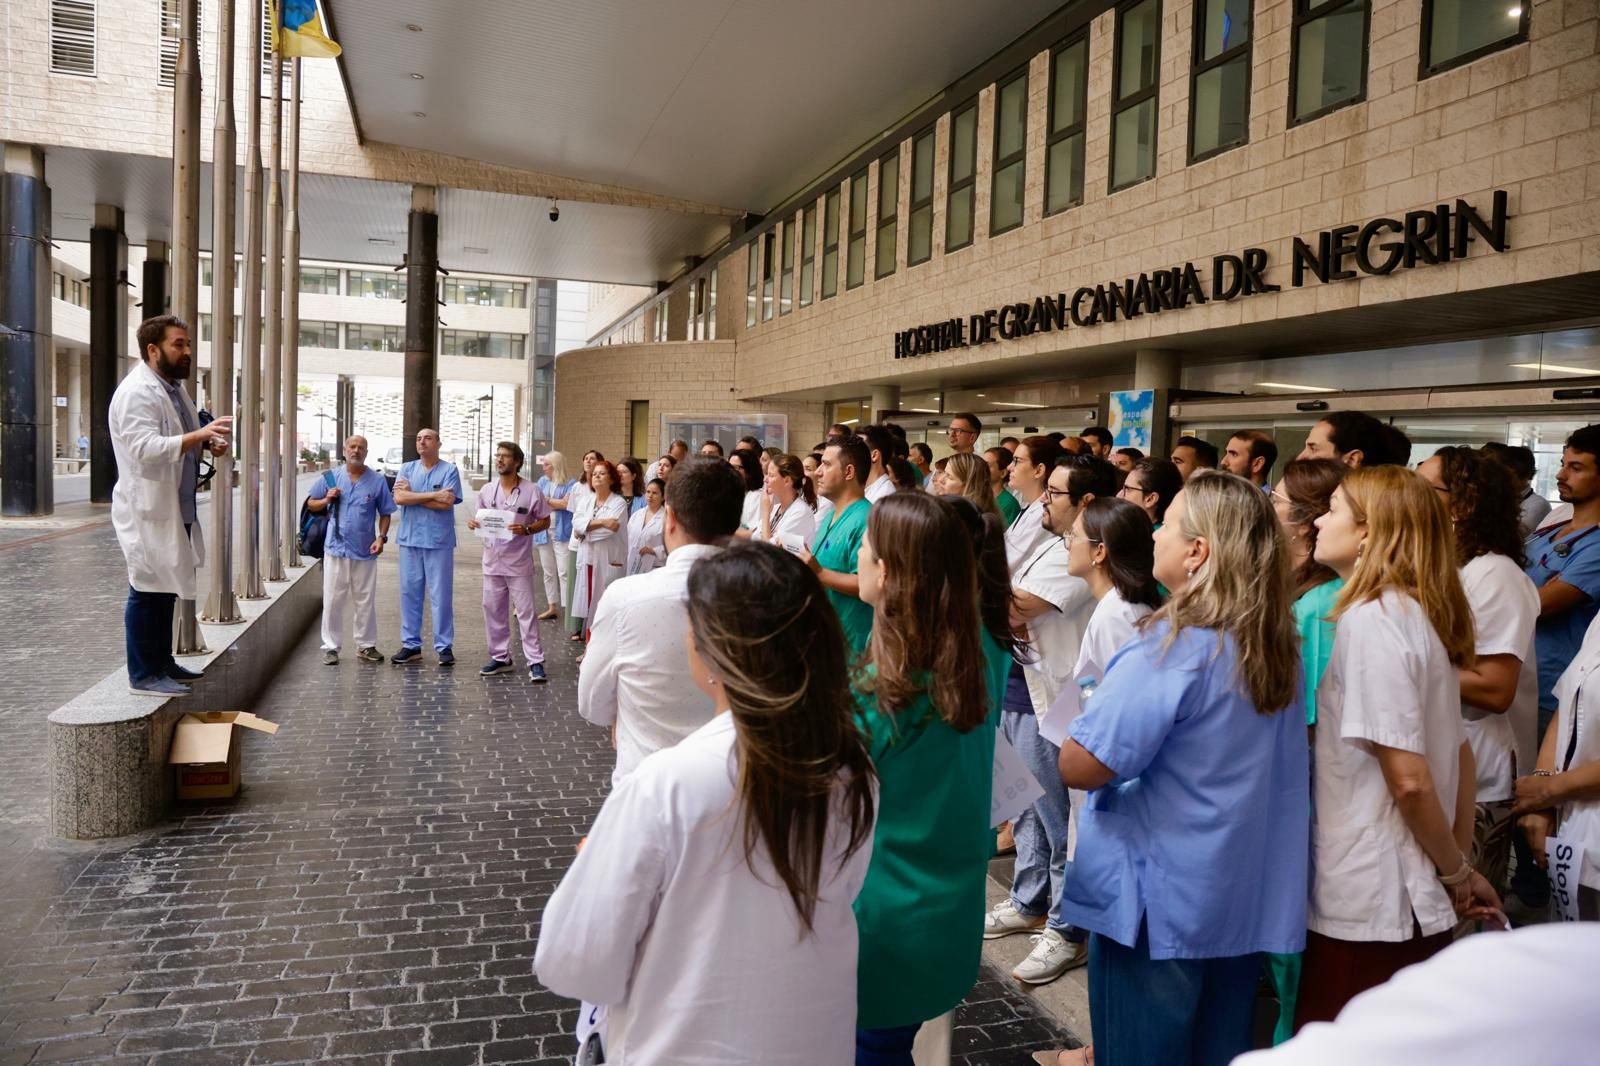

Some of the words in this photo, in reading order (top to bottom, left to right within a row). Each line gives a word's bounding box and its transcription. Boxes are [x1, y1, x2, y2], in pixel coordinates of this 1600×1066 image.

[895, 318, 968, 359] HOSPITAL
[970, 309, 997, 346] DE
[998, 293, 1066, 340] GRAN
[1071, 262, 1206, 327] CANARIA
[1292, 190, 1507, 287] NEGRIN
[1556, 844, 1573, 906] Stop
